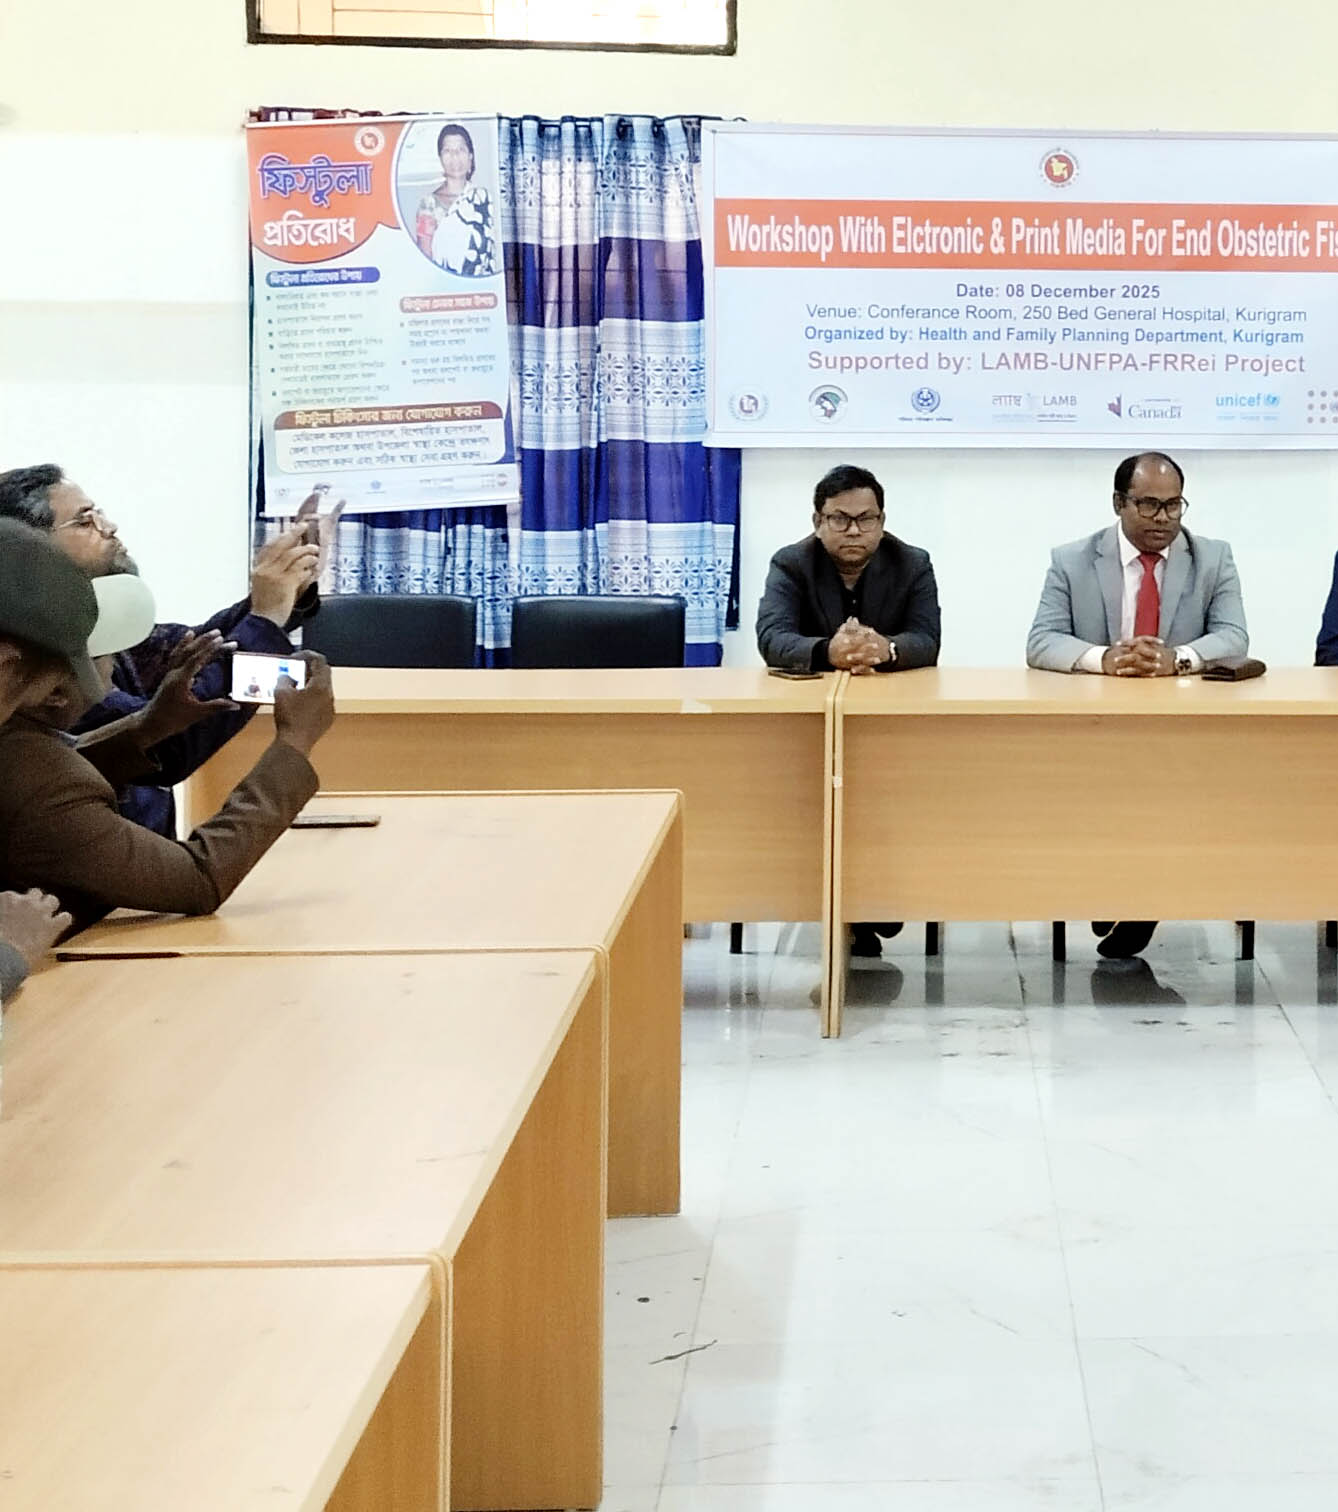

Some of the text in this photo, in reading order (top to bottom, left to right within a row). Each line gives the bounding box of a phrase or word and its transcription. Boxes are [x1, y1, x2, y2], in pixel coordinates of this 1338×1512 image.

[260, 153, 372, 207] ফিস্টুলা
[263, 211, 356, 247] প্রতিরোধ
[728, 215, 833, 262] Workshop
[840, 216, 885, 253] With
[893, 217, 984, 254] Elctronic
[990, 217, 1005, 254] &
[1012, 218, 1060, 255] Print
[1066, 218, 1125, 255] Media
[1132, 219, 1167, 256] For
[1172, 220, 1211, 256] End
[1217, 220, 1310, 257] Obstetric
[957, 284, 1160, 298] Date: 08 December 2025
[806, 304, 1306, 324] Venue: Conferance Room, 250 Bed General Hospital, Kurigram
[805, 326, 1303, 346] Organized by: Health and Family Planning Department, Kurigram
[808, 351, 1304, 376] Supported by: LAMB-UNFPA-FRRei Project
[1043, 395, 1077, 406] LAMB
[1216, 393, 1261, 407] unicef
[1128, 402, 1182, 419] Canada
